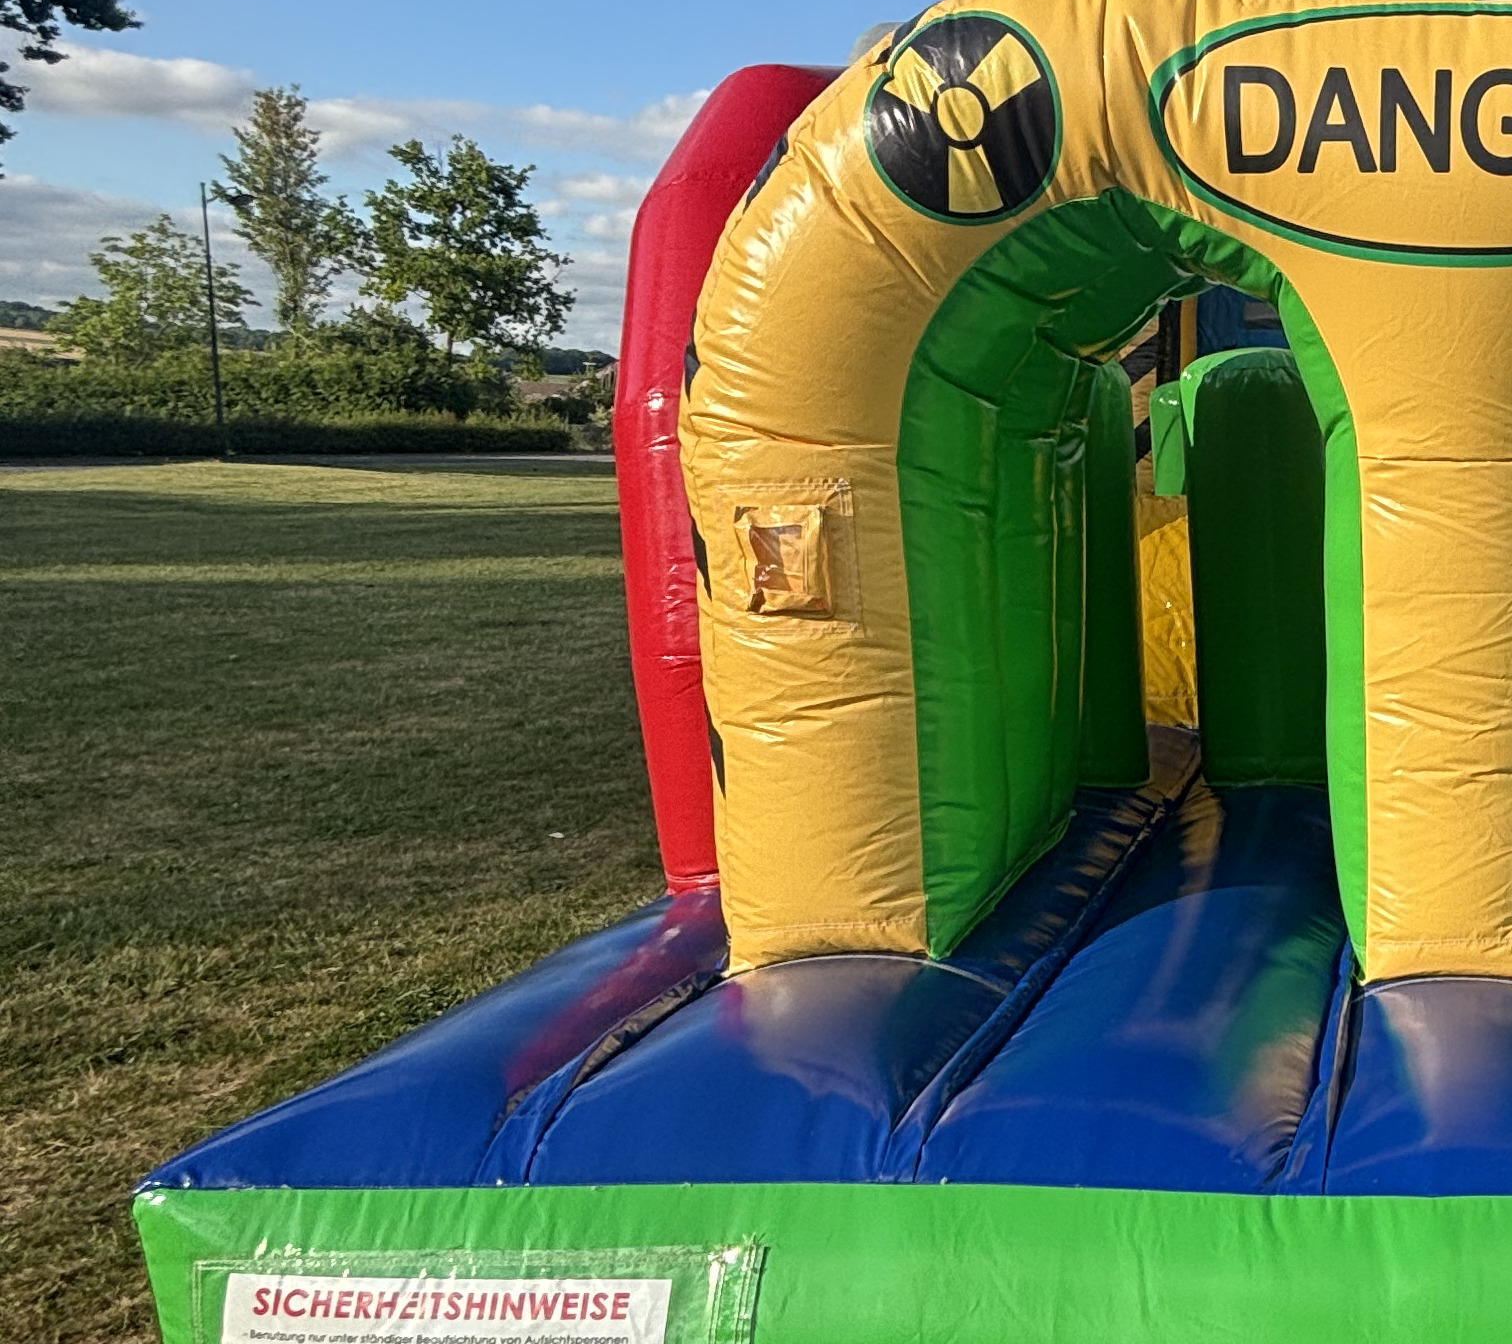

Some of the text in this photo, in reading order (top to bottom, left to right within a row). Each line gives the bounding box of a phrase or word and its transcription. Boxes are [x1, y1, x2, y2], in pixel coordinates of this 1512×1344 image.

[253, 1288, 630, 1320] SICHERHEITSHINWEISE
[250, 1330, 305, 1343] Benutzung
[308, 1334, 325, 1342] nur
[329, 1334, 357, 1343] unter
